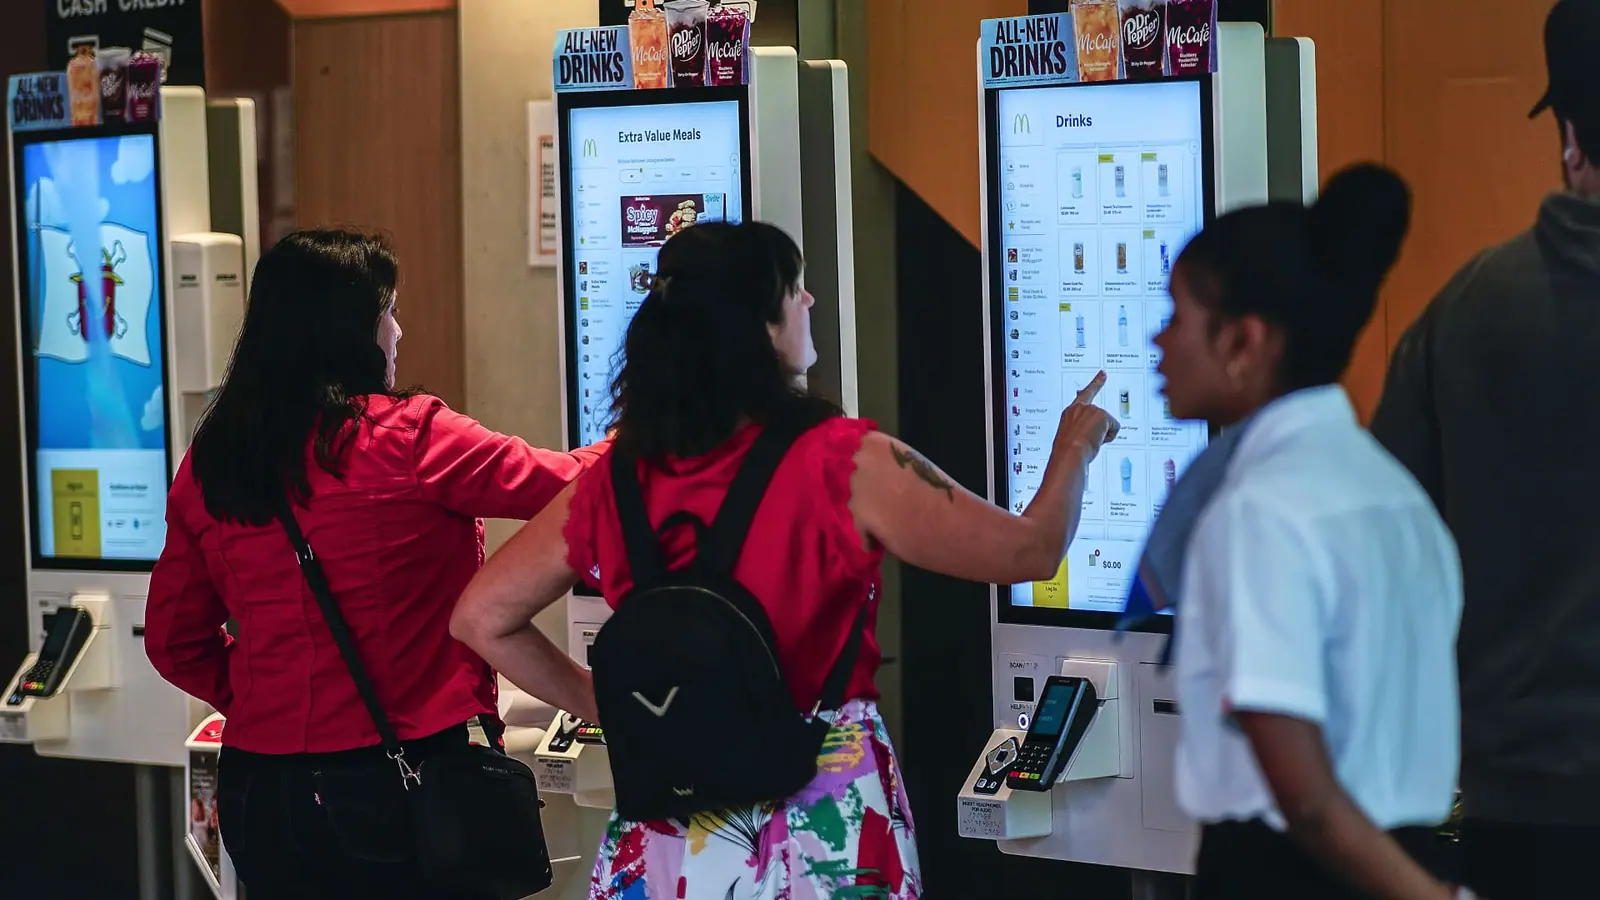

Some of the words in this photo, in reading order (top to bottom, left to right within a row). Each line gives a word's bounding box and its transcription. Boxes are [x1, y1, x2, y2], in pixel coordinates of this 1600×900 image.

[996, 16, 1059, 44] ALL-NEW
[1126, 17, 1158, 46] Pepper
[1135, 14, 1150, 28] Dr
[565, 29, 618, 54] ALL-NEW
[671, 32, 700, 58] Pepper
[681, 29, 693, 41] Dr
[1079, 32, 1118, 54] McCafé
[1168, 23, 1210, 48] McCafé
[632, 45, 667, 65] McCafé
[707, 39, 742, 61] McCafé
[990, 41, 1067, 77] DRINKS
[560, 53, 624, 84] DRINKS
[18, 75, 59, 94] ALL-NEW
[14, 96, 64, 122] DRINKS
[1056, 114, 1093, 128] Drinks
[619, 131, 643, 143] Extra
[644, 129, 671, 142] Value
[673, 127, 701, 141] Meals
[626, 203, 658, 225] Spicy
[627, 226, 658, 235] McNuggets
[1102, 560, 1122, 569] $0.00
